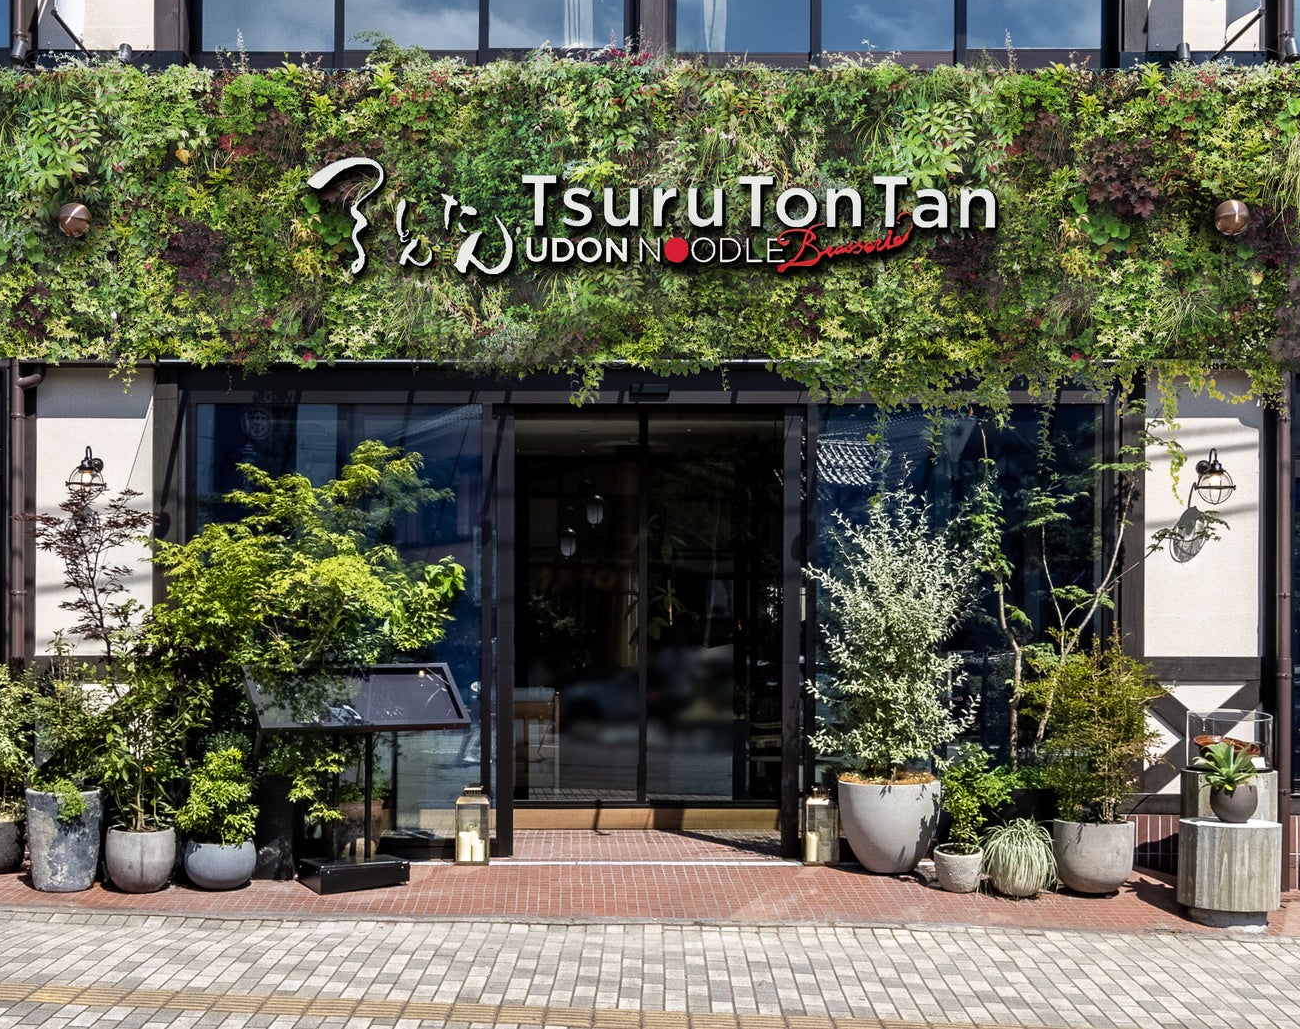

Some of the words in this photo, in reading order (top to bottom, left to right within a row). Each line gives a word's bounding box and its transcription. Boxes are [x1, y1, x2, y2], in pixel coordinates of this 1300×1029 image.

[526, 237, 628, 263] UDON
[639, 237, 786, 263] NOODLE
[776, 212, 914, 273] Brasserie
